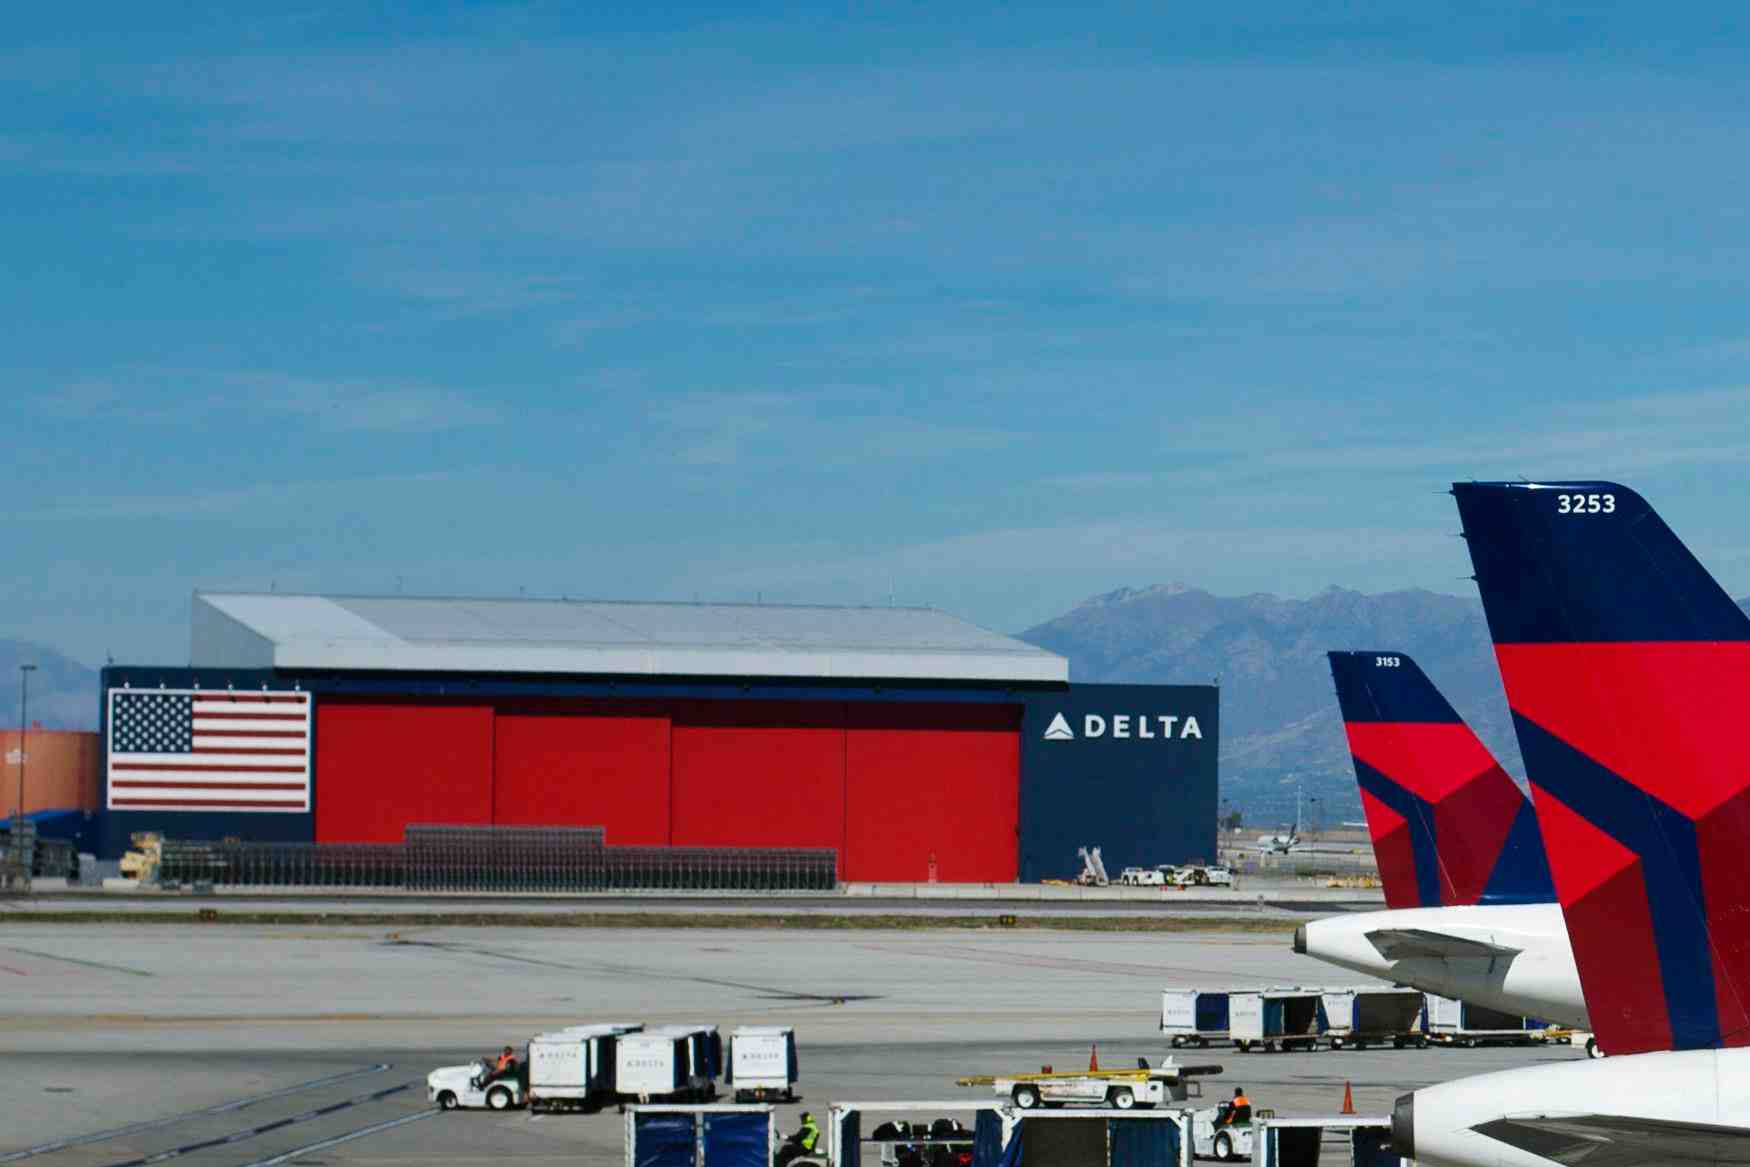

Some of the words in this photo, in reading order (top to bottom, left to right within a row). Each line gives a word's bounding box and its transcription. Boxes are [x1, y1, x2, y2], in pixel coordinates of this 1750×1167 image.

[1557, 493, 1616, 514] 3253
[1375, 655, 1401, 668] 3153
[1083, 713, 1203, 740] DELTA
